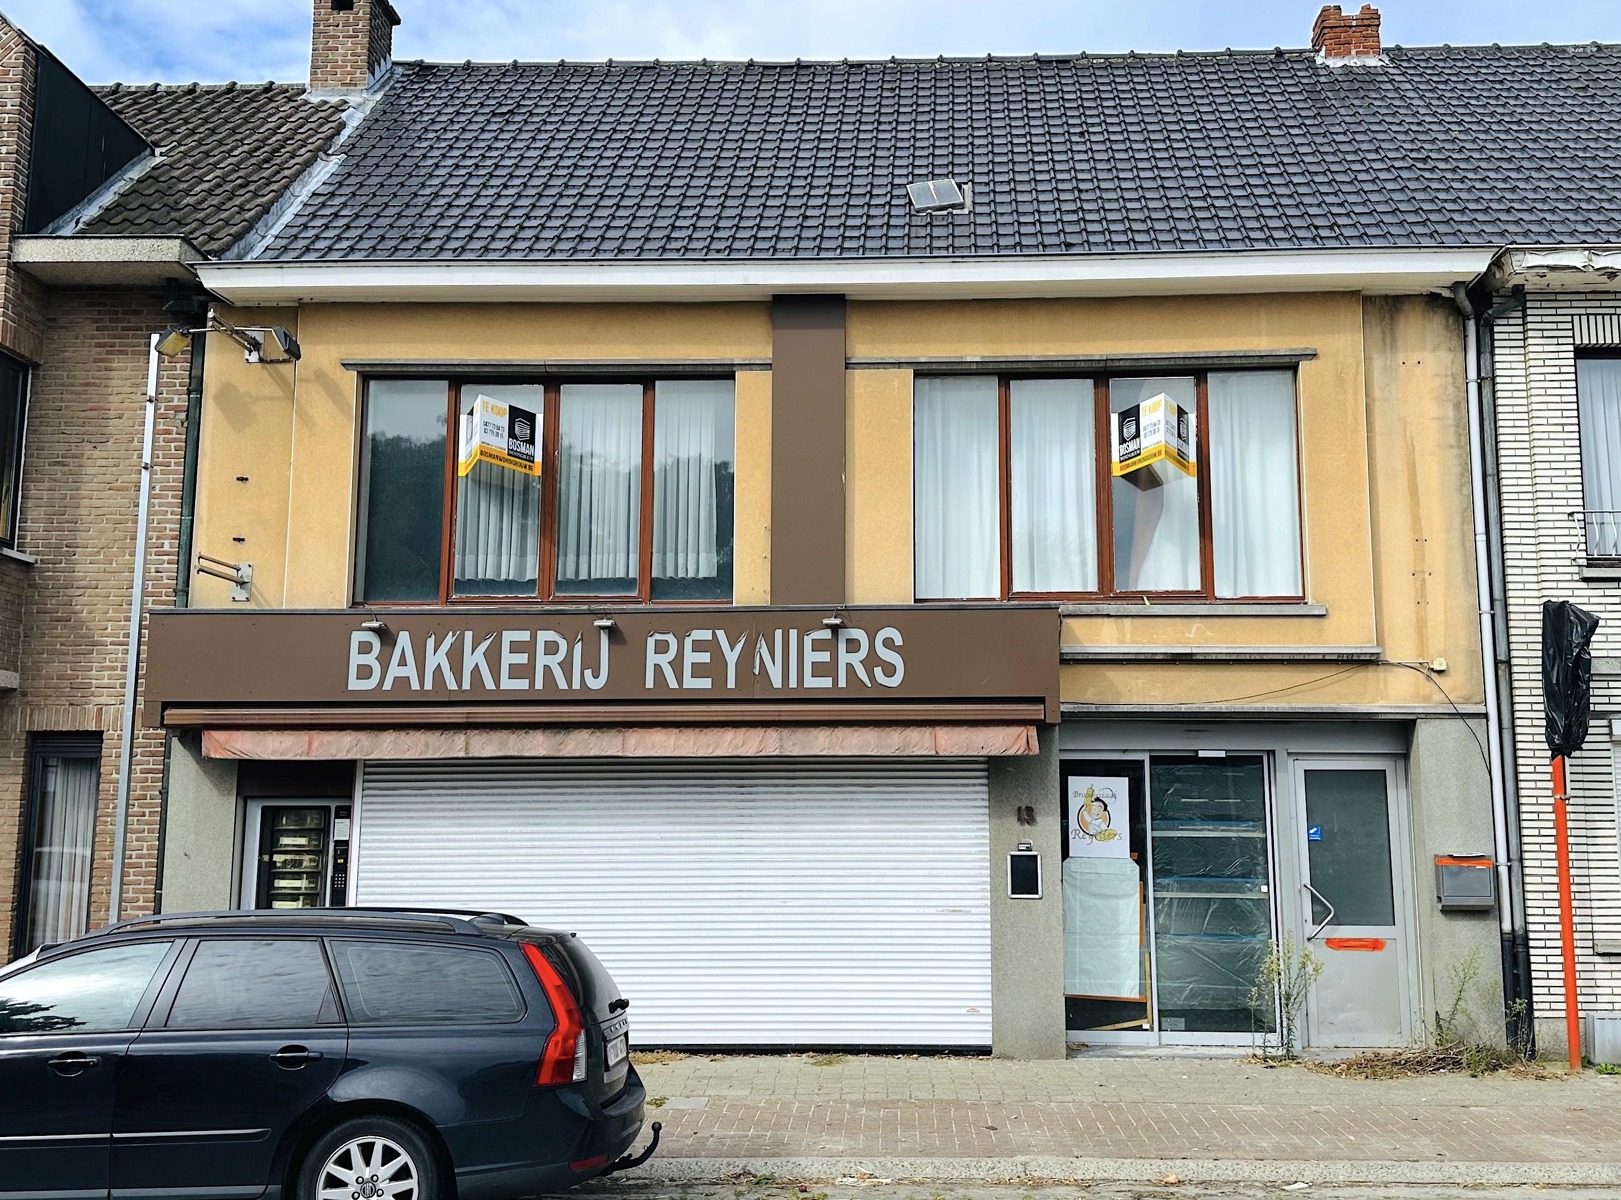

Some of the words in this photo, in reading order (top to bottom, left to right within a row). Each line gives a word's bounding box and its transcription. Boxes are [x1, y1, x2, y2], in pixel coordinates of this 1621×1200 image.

[482, 401, 489, 413] TE
[491, 404, 507, 417] KOOP
[509, 437, 535, 456] BOSMAN
[347, 629, 609, 691] BAKKERIJ
[645, 626, 905, 689] REYNIERS
